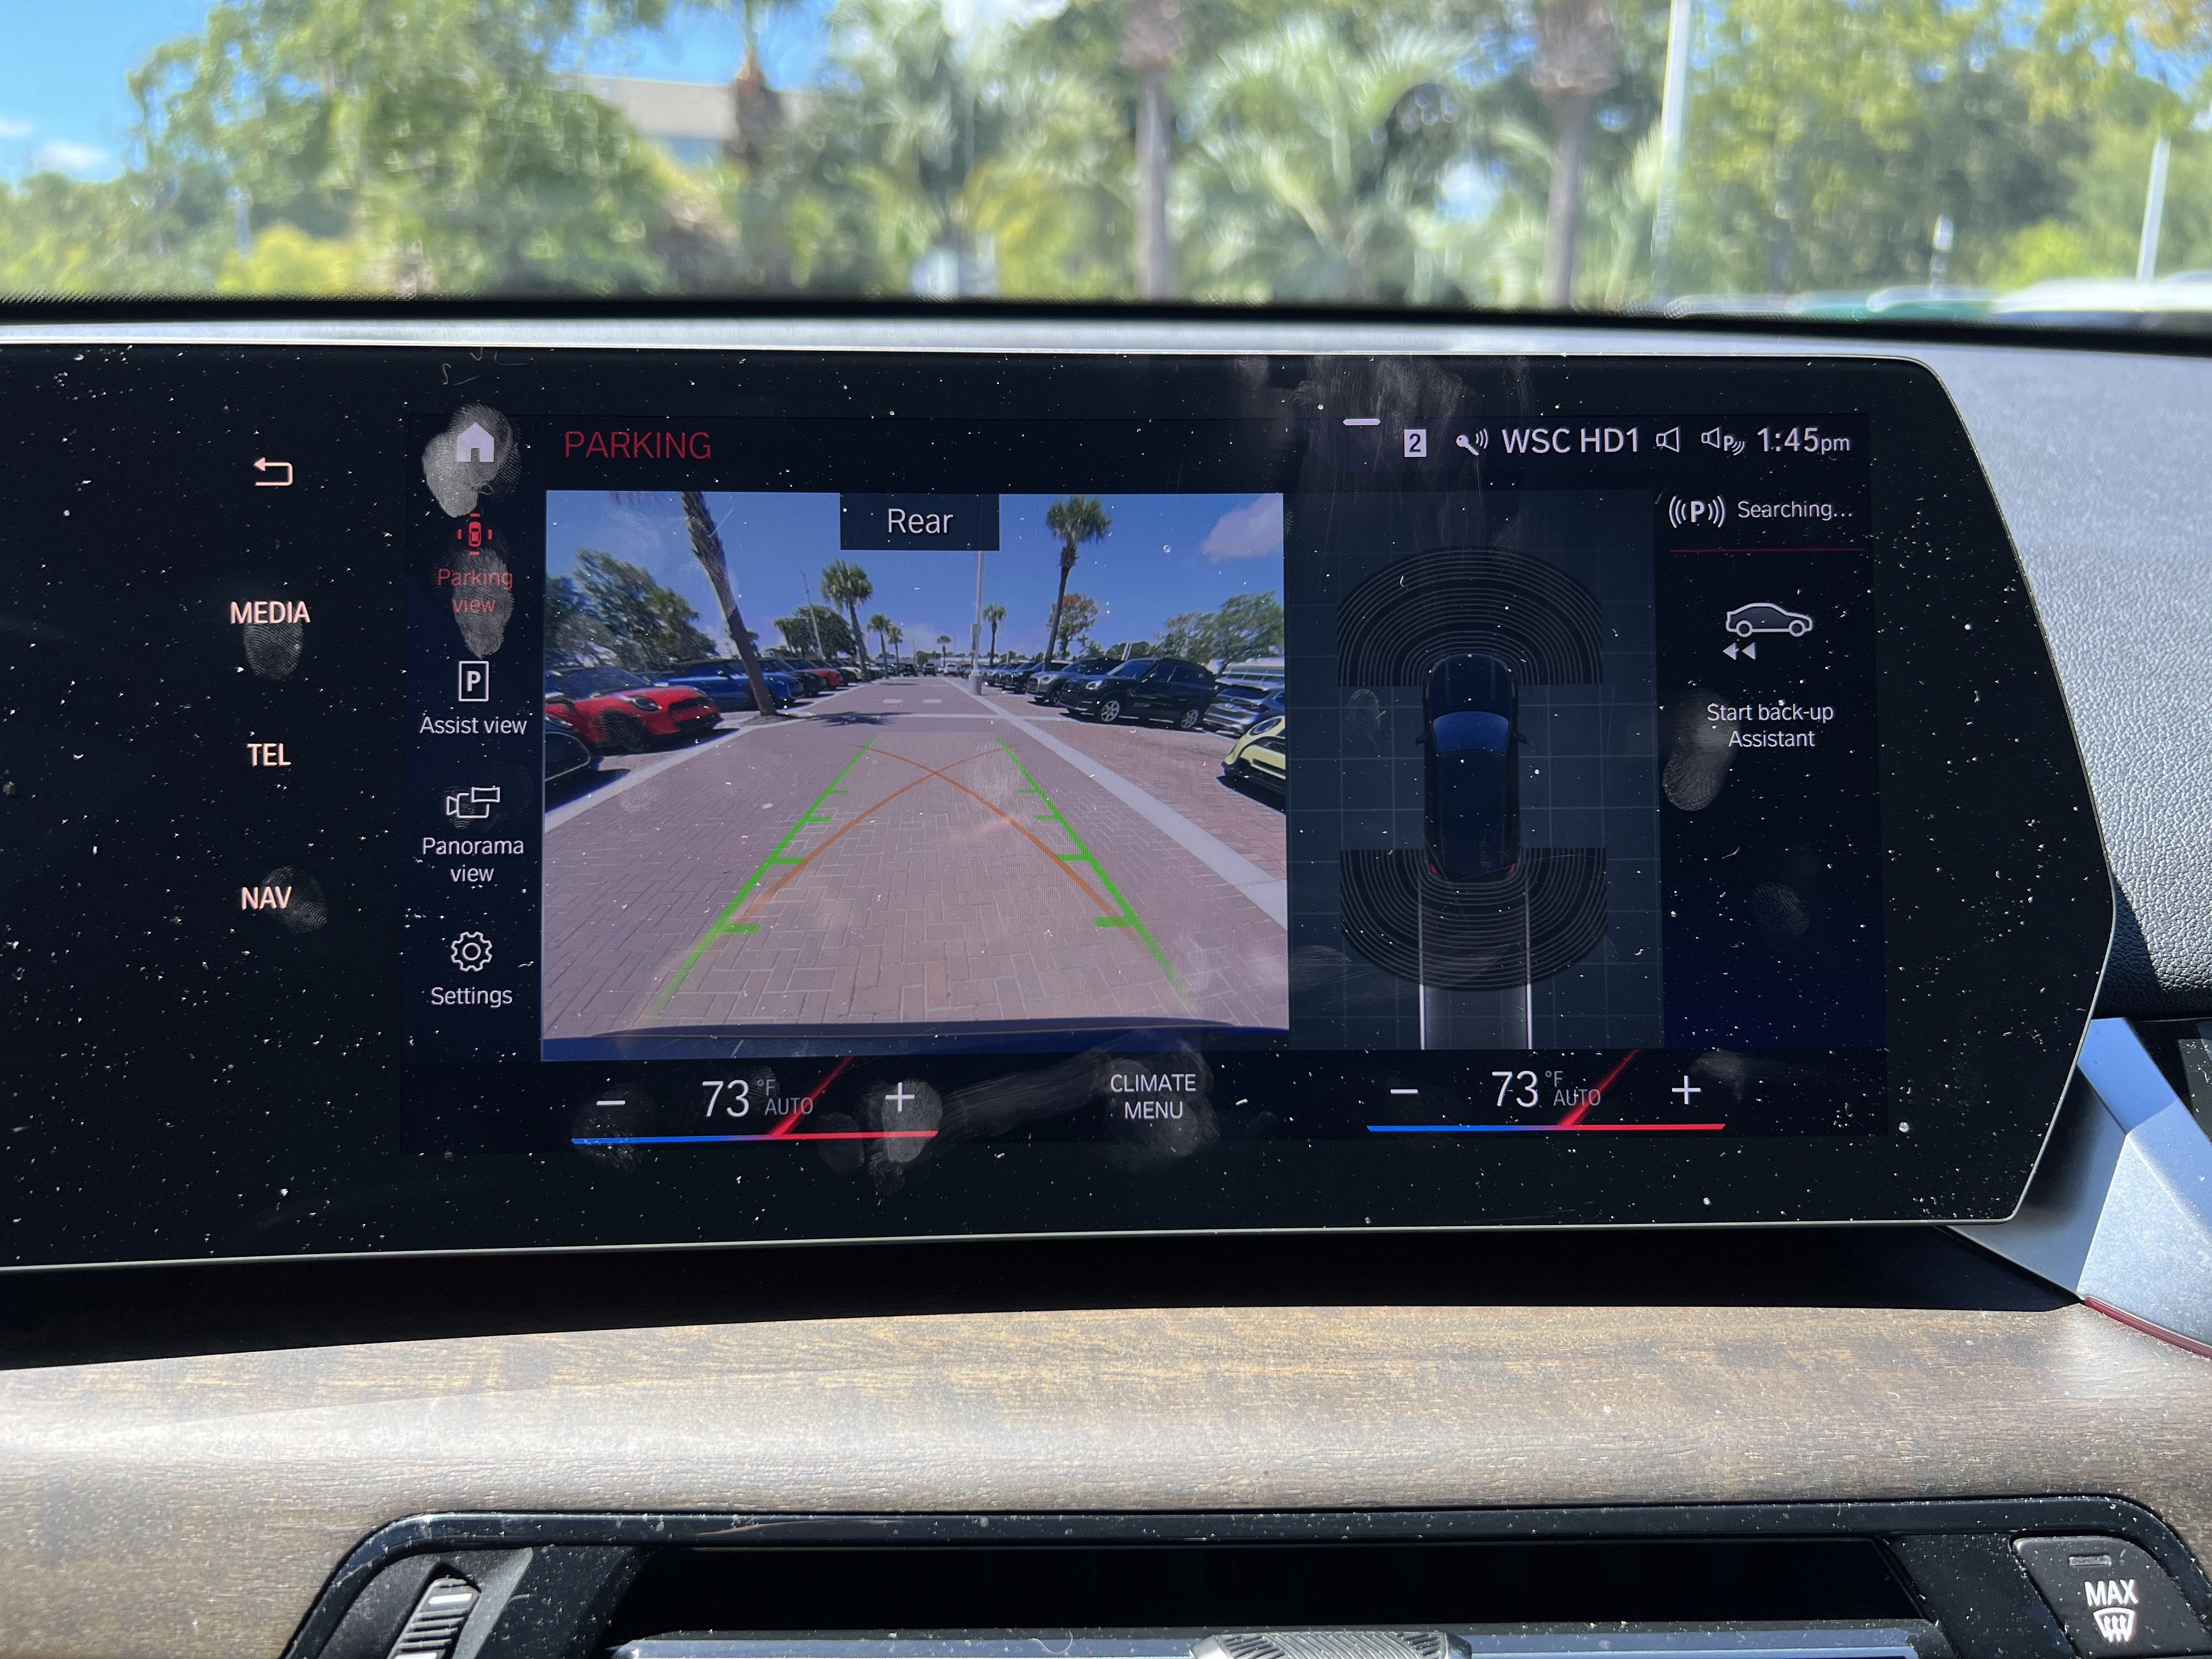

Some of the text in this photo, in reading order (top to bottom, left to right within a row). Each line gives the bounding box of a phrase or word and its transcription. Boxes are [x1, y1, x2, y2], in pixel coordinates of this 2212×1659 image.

[563, 431, 713, 460] PARKING
[1409, 433, 1421, 452] 2
[1502, 428, 1639, 454] WSC HD1
[1723, 435, 1734, 449] P
[1757, 428, 1851, 454] 1:45pm
[887, 508, 953, 534] Rear
[1690, 501, 1704, 522] P
[437, 568, 513, 589] Parking
[230, 601, 311, 624] MEDIA
[452, 599, 495, 613] view
[467, 670, 481, 691] P
[1707, 702, 1834, 723] Start back-up
[420, 716, 527, 735] Assist view
[1728, 730, 1815, 748] Assistant
[248, 743, 291, 768] TEL
[422, 838, 524, 855] Panorama
[450, 865, 494, 882] view
[239, 887, 293, 910] NAV
[431, 987, 512, 1008] Settings
[1110, 1074, 1196, 1093] CLIMATE
[1491, 1070, 1539, 1107] 73
[701, 1080, 749, 1117] 73
[765, 1097, 814, 1116] AUTO
[1553, 1088, 1601, 1107] AUTO
[1125, 1100, 1183, 1120] MENU
[2084, 1579, 2138, 1606] MAX
